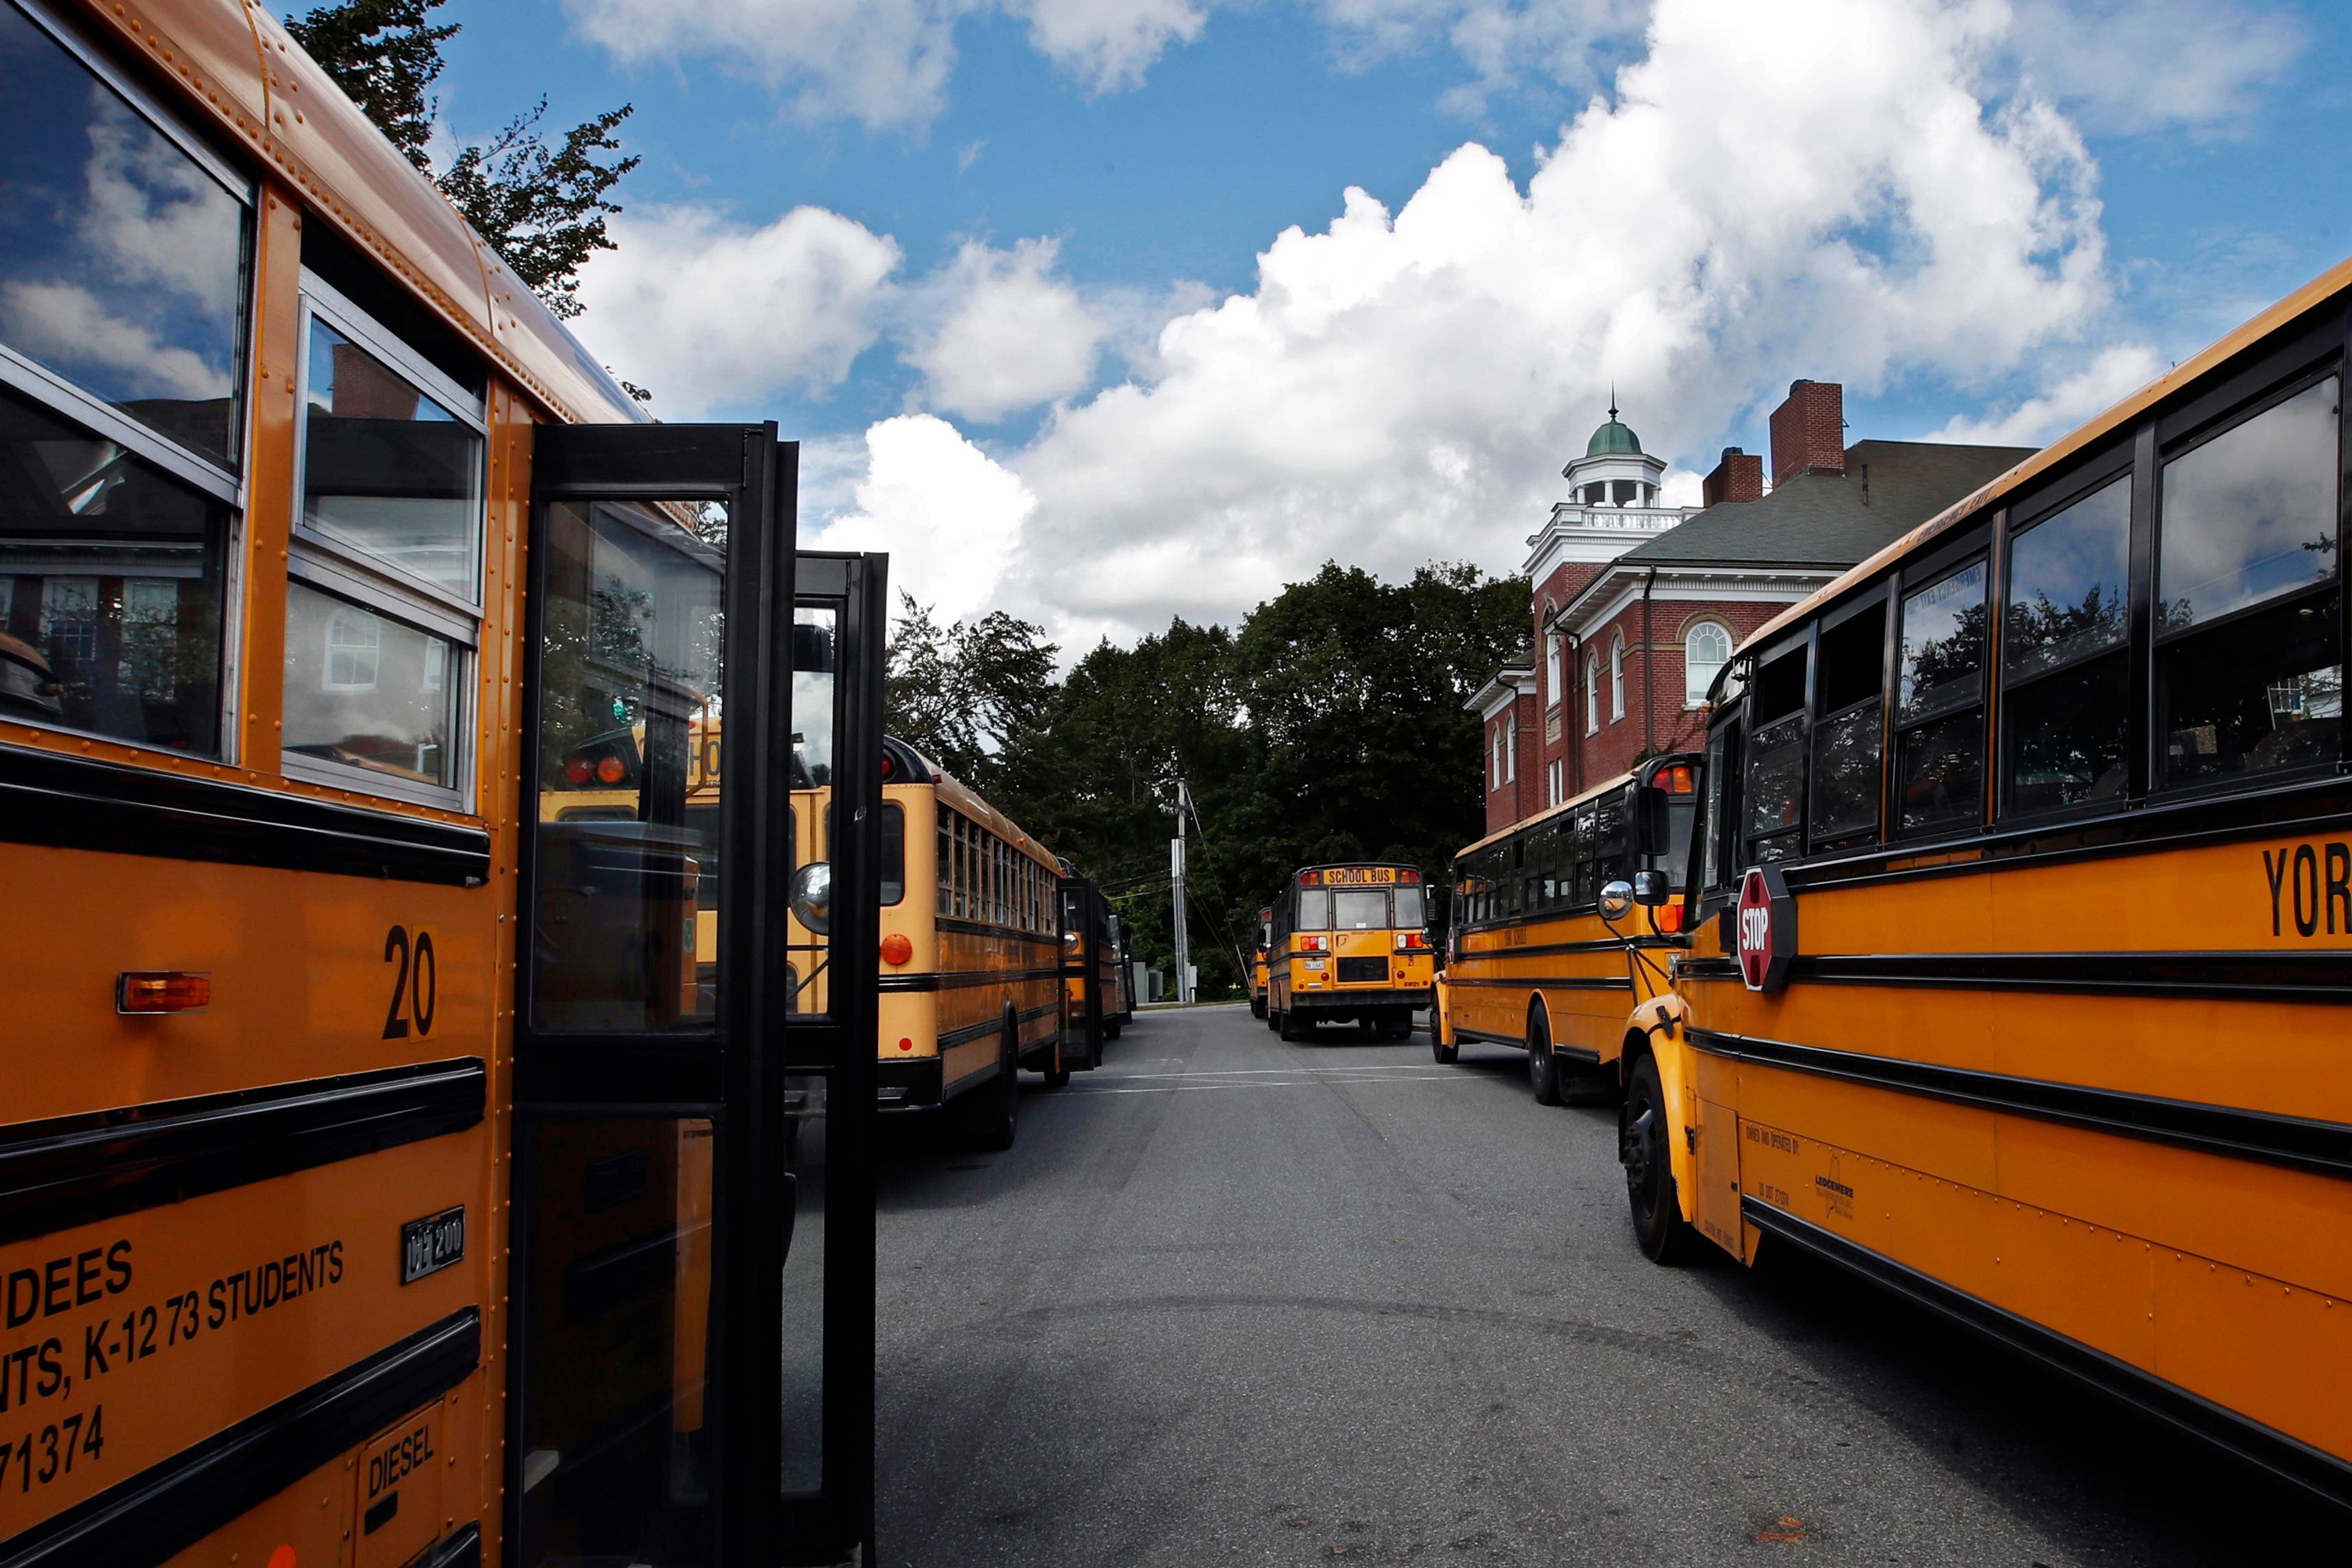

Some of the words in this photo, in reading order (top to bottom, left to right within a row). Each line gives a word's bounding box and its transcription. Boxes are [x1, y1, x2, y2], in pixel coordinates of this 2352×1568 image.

[1329, 870, 1367, 883] SCHOOL
[1371, 869, 1390, 883] BUS
[1742, 908, 1768, 951] STOP
[382, 925, 435, 1039] 20
[1815, 1175, 1853, 1199] LEDGEMERE
[435, 1218, 461, 1259] 200
[0, 1239, 132, 1330] DEES
[84, 1305, 157, 1380] K-12
[167, 1291, 200, 1347] 73
[208, 1240, 344, 1330] STUDENTS
[369, 1423, 434, 1499] DIESEL
